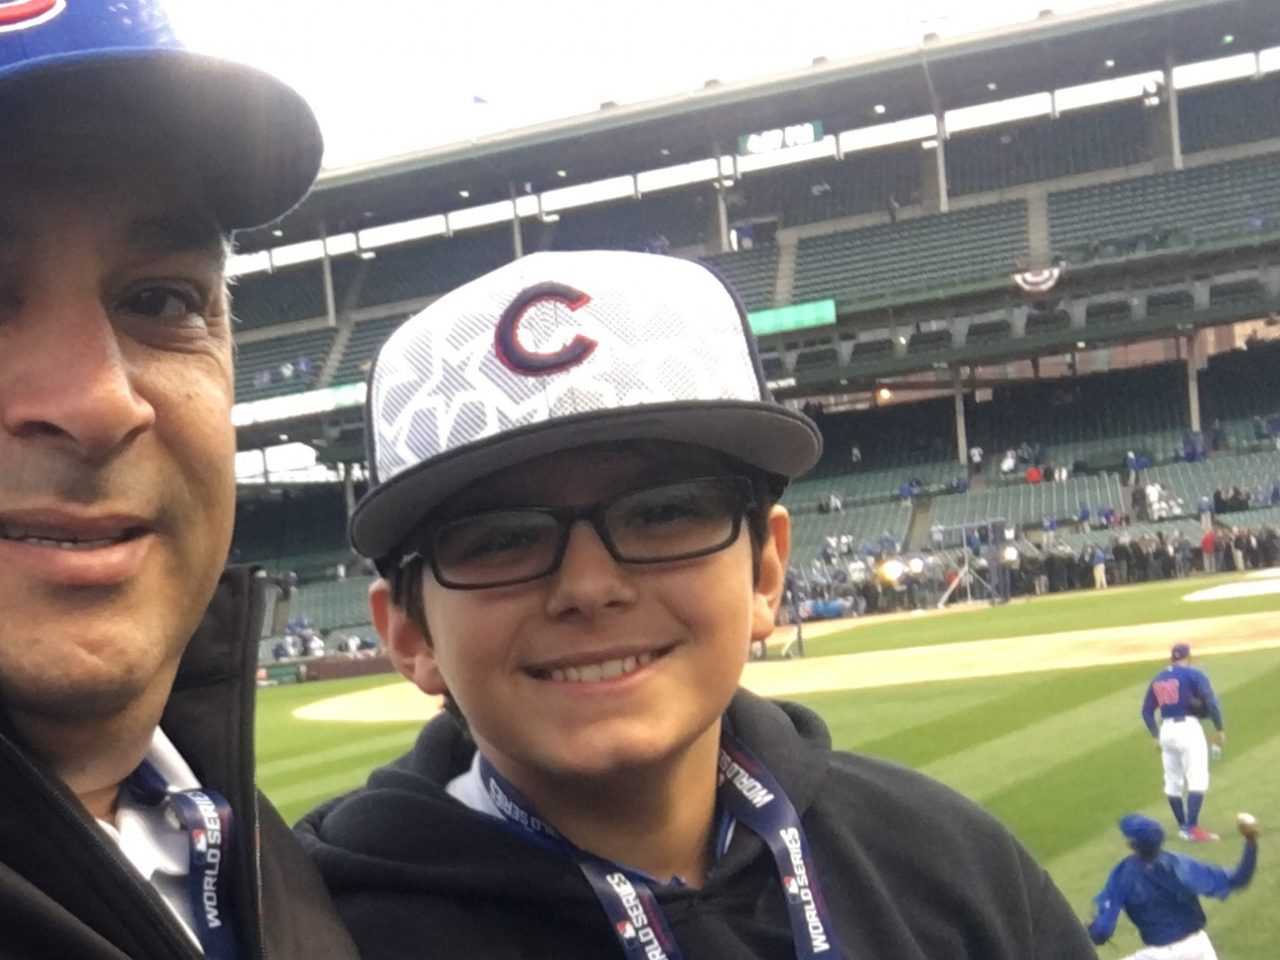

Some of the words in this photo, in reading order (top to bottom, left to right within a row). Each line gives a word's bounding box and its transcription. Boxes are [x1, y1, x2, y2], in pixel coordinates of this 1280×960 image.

[494, 281, 598, 377] C
[726, 762, 775, 808] WORLD
[184, 791, 222, 844] SERIE
[780, 827, 808, 887] SERIES
[202, 849, 222, 928] WORLD
[606, 872, 648, 929] SERIES
[800, 887, 830, 953] WORLD
